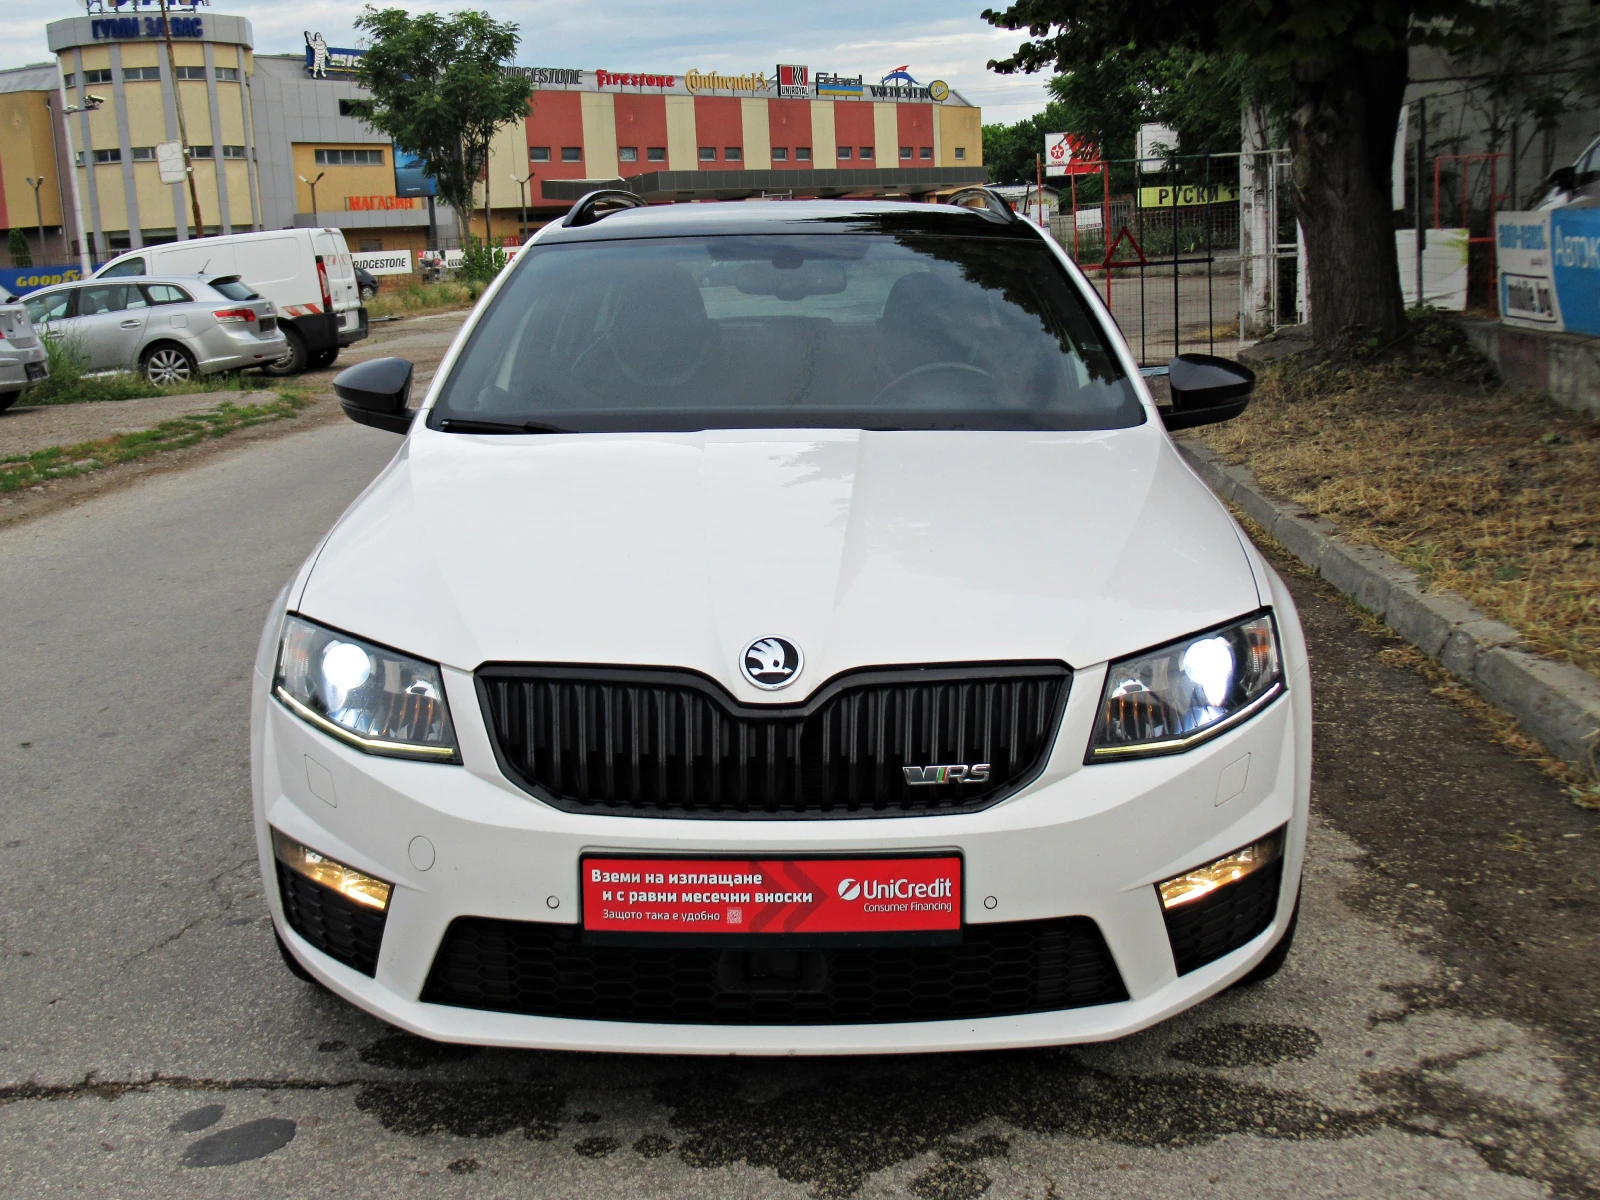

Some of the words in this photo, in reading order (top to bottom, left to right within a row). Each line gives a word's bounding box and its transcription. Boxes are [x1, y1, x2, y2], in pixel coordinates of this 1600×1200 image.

[92, 17, 140, 39] ГУМИ
[144, 16, 168, 37] ЗА
[171, 17, 203, 38] ВАС
[595, 69, 676, 88] Firestone
[685, 68, 758, 95] Continental
[781, 86, 809, 96] UNIROYAL
[349, 195, 415, 211] МАГАЗИН
[353, 257, 406, 269] RIDGESTONE
[16, 270, 80, 287] GOODY
[591, 869, 641, 884] Вземи
[645, 873, 664, 884] на
[668, 872, 763, 886] изплащане
[863, 877, 952, 899] UniCredit
[602, 890, 612, 901] и
[616, 890, 625, 901] с
[629, 890, 677, 904] равни
[681, 891, 750, 903] месечни
[755, 891, 813, 903] вноски
[863, 902, 909, 912] Consumer
[910, 901, 952, 913] Financing
[602, 909, 643, 921] Защото
[646, 911, 670, 921] така
[672, 911, 679, 921] е
[681, 910, 720, 922] удобно
